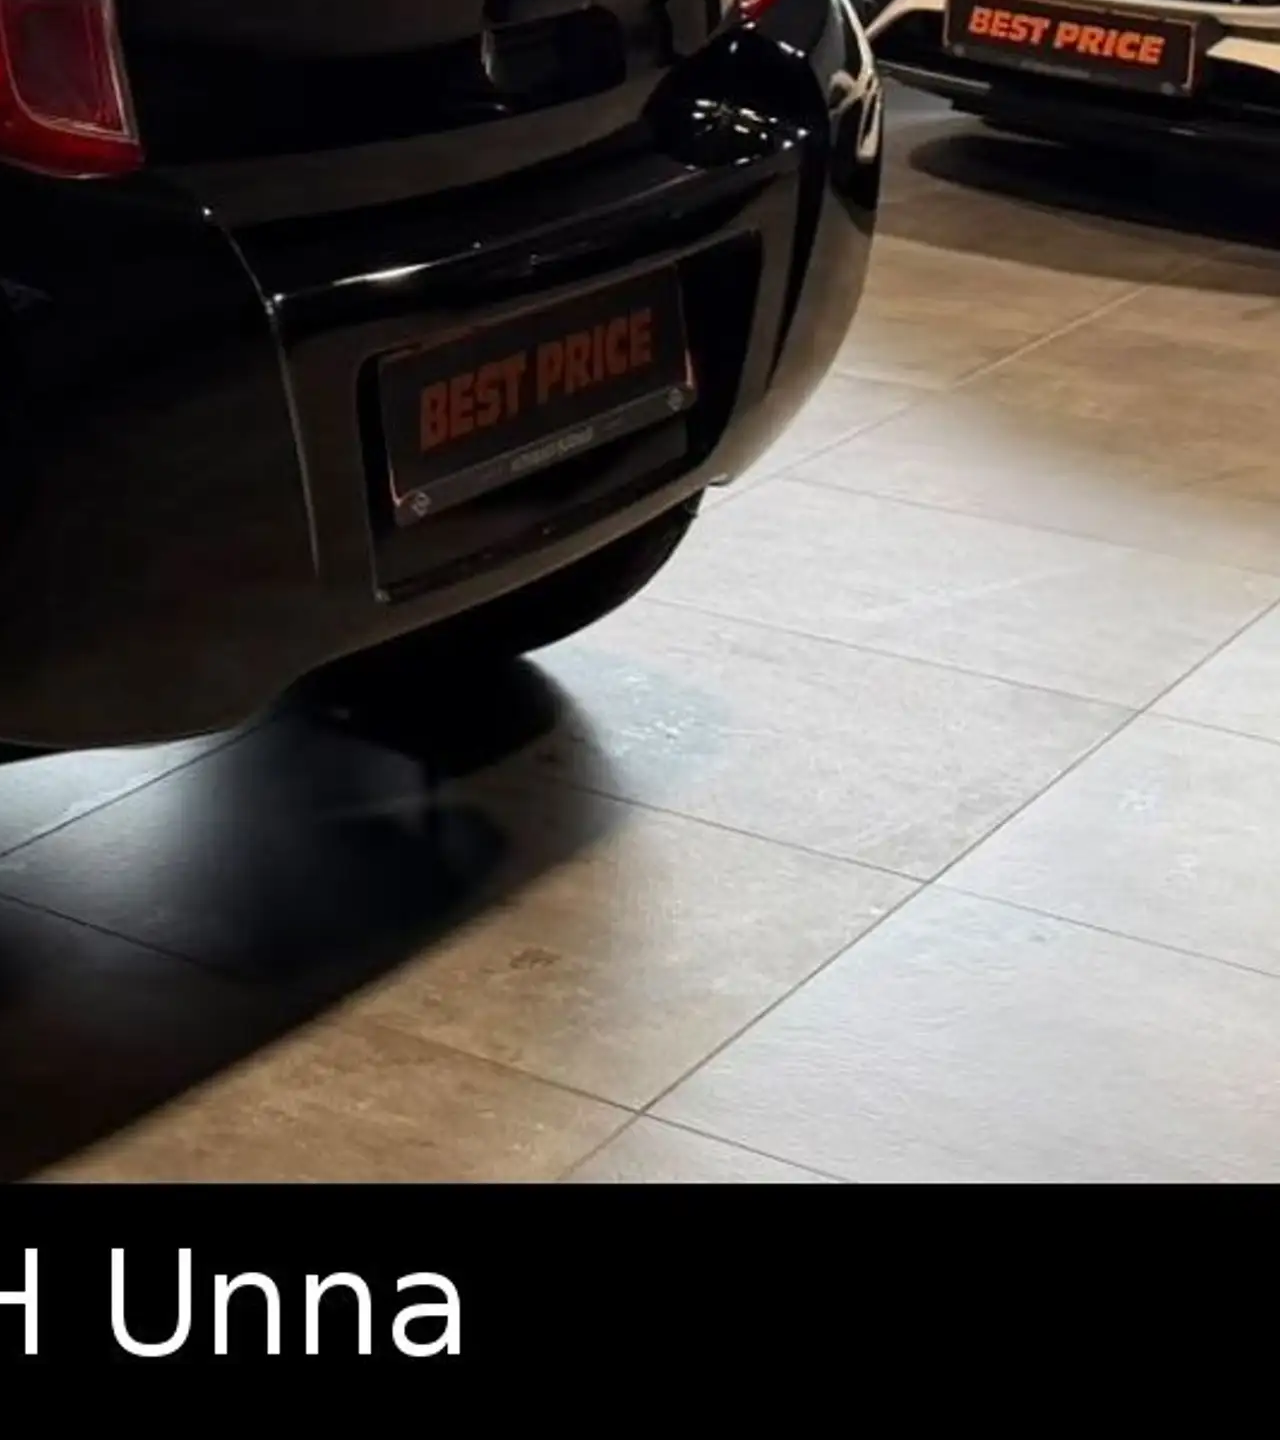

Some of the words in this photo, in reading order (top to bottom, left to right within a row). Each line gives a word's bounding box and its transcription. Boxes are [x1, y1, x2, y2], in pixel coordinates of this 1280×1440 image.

[968, 5, 1050, 46] BEST
[1053, 21, 1166, 66] PRICE
[419, 350, 526, 453] BEST
[538, 307, 653, 405] PRICE
